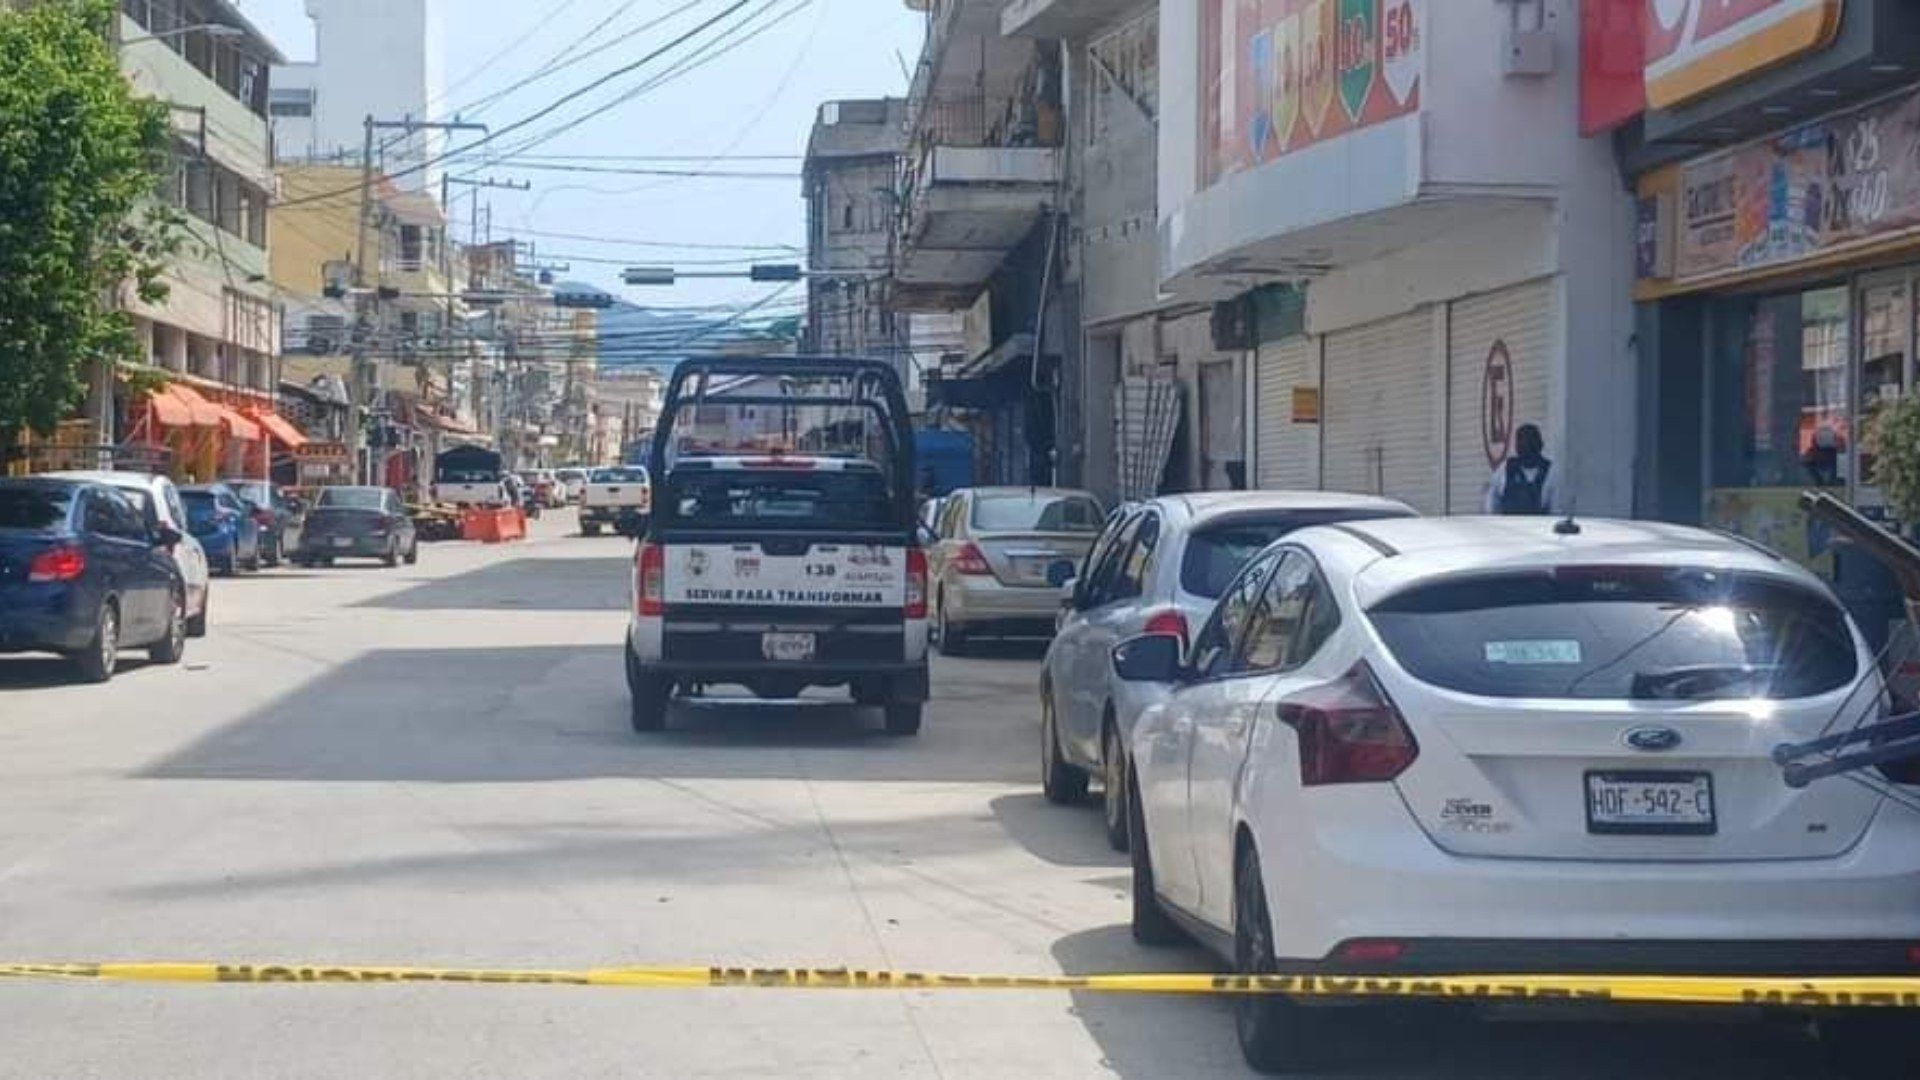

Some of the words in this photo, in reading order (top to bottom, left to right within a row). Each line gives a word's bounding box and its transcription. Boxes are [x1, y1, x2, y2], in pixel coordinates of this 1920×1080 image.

[804, 563, 835, 577] 138
[686, 589, 732, 600] SERVIR
[736, 589, 773, 601] PARA
[779, 590, 882, 603] TRANSFORMAR
